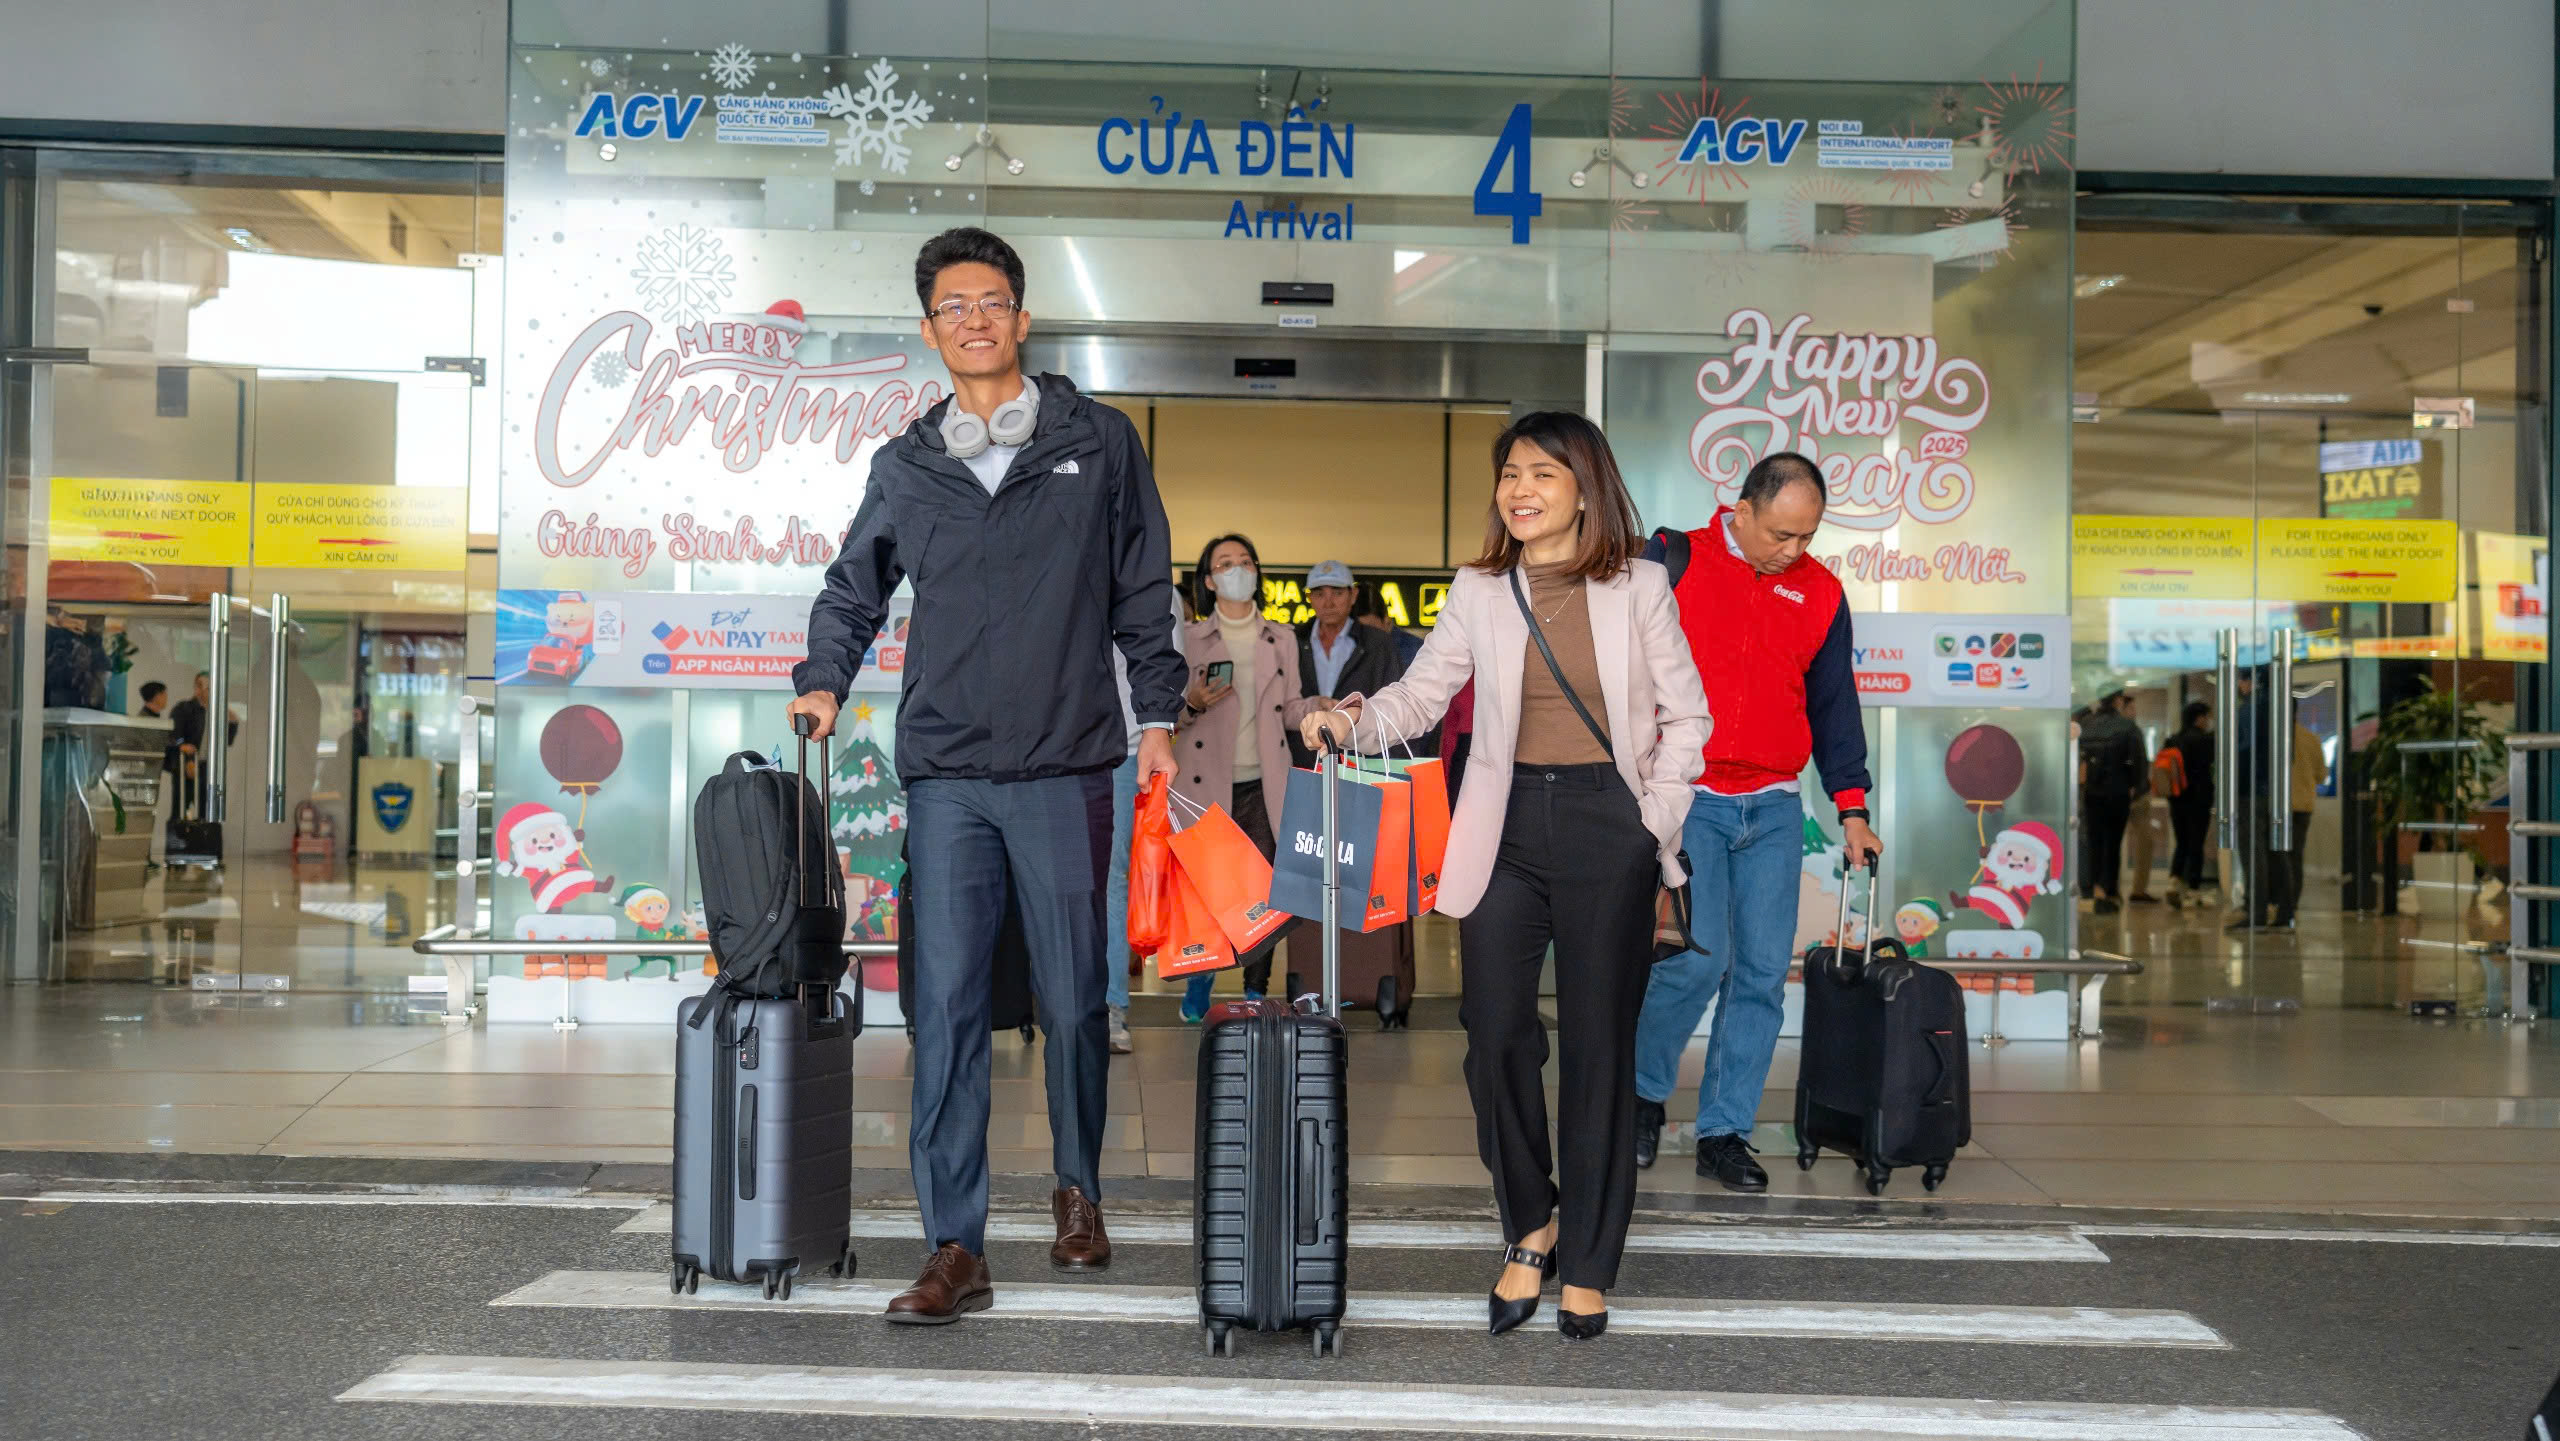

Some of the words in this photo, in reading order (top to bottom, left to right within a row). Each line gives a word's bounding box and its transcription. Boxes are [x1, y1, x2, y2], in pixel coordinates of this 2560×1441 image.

[719, 94, 750, 109] CẢNG
[753, 95, 784, 110] HÀNG
[788, 96, 828, 111] KHÔNG
[575, 95, 704, 139] ACV
[718, 111, 749, 125] QUỐC
[752, 111, 766, 124] TẾ
[769, 115, 790, 127] NỘI
[792, 113, 813, 126] BÀI
[1820, 122, 1839, 131] NOI
[1841, 123, 1860, 132] BAI
[1098, 95, 1220, 175] CỬA
[1236, 100, 1353, 178] ĐẾN
[1679, 119, 1805, 164] ACV
[1820, 139, 1903, 149] INTERNATIONAL
[1906, 140, 1950, 150] AIRPORT
[1474, 104, 1542, 244] 4
[1224, 200, 1353, 240] Arrival
[676, 322, 803, 361] MERRY
[1696, 308, 1989, 433] Happy
[1766, 386, 1899, 437] New
[1924, 434, 1966, 455] 2025
[187, 493, 221, 505] ONLY
[161, 508, 194, 521] NEXT
[198, 511, 237, 523] DOOR
[538, 510, 657, 579] Giáng
[662, 513, 764, 562] Sinh
[766, 515, 833, 565] An
[2287, 530, 2312, 541] FOR
[2315, 530, 2394, 542] TECHNICIANS
[2397, 531, 2429, 543] ONLY
[150, 548, 180, 558] YOU!
[324, 552, 345, 562] XIN
[2270, 547, 2315, 558] PLEASE
[2320, 547, 2345, 559] USE
[2348, 548, 2370, 559] THE
[2373, 548, 2405, 559] NEXT
[2408, 549, 2443, 560] DOOR
[1847, 541, 1932, 583] Năm
[1934, 541, 2027, 585] Mới
[2325, 585, 2361, 595] THANK
[2365, 585, 2393, 595] YOU!
[693, 630, 767, 649] VNPAY
[768, 631, 805, 645] TAXI
[1869, 648, 1904, 661] TAXI
[675, 659, 707, 672] APP
[710, 656, 756, 673] NGÂN
[1859, 674, 1904, 690] HÀNG
